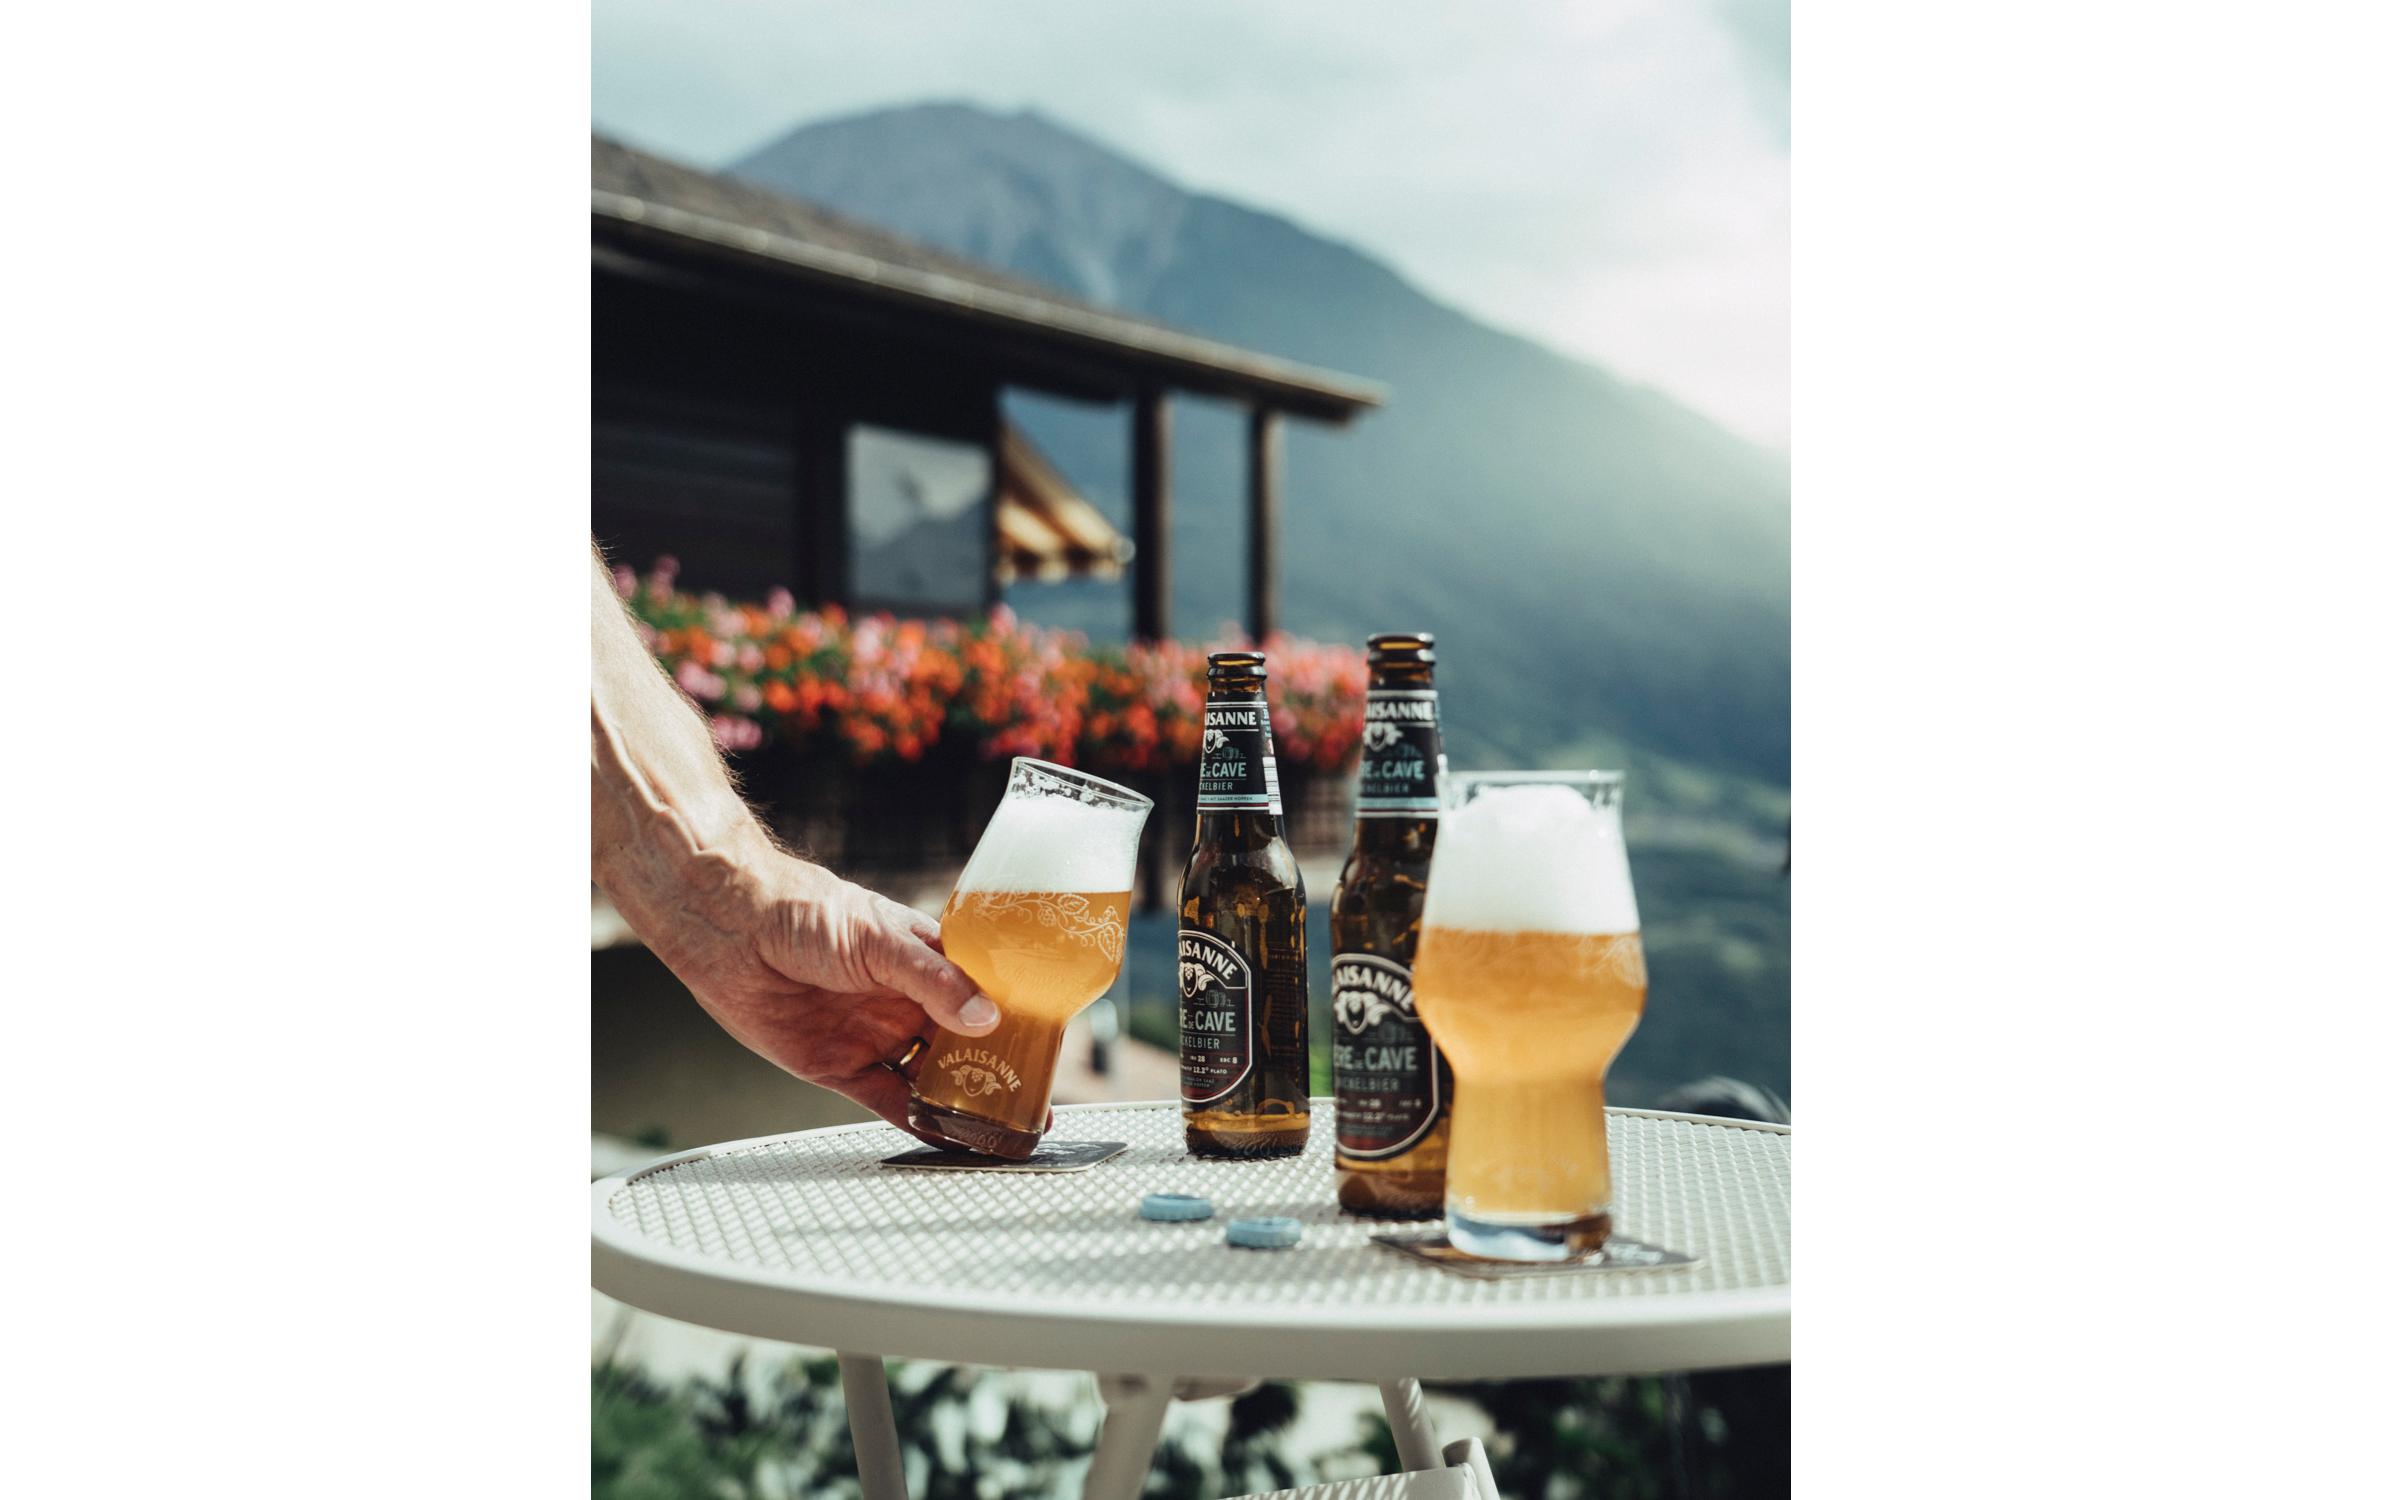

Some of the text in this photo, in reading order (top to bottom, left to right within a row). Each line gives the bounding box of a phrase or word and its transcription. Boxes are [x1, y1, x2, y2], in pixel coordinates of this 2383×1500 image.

[1212, 762, 1247, 778] CAVE
[1382, 760, 1424, 780] CAVE
[1195, 1010, 1236, 1032] CAVE
[938, 1048, 1022, 1092] VALAISANNE
[1364, 1046, 1418, 1072] CAVE
